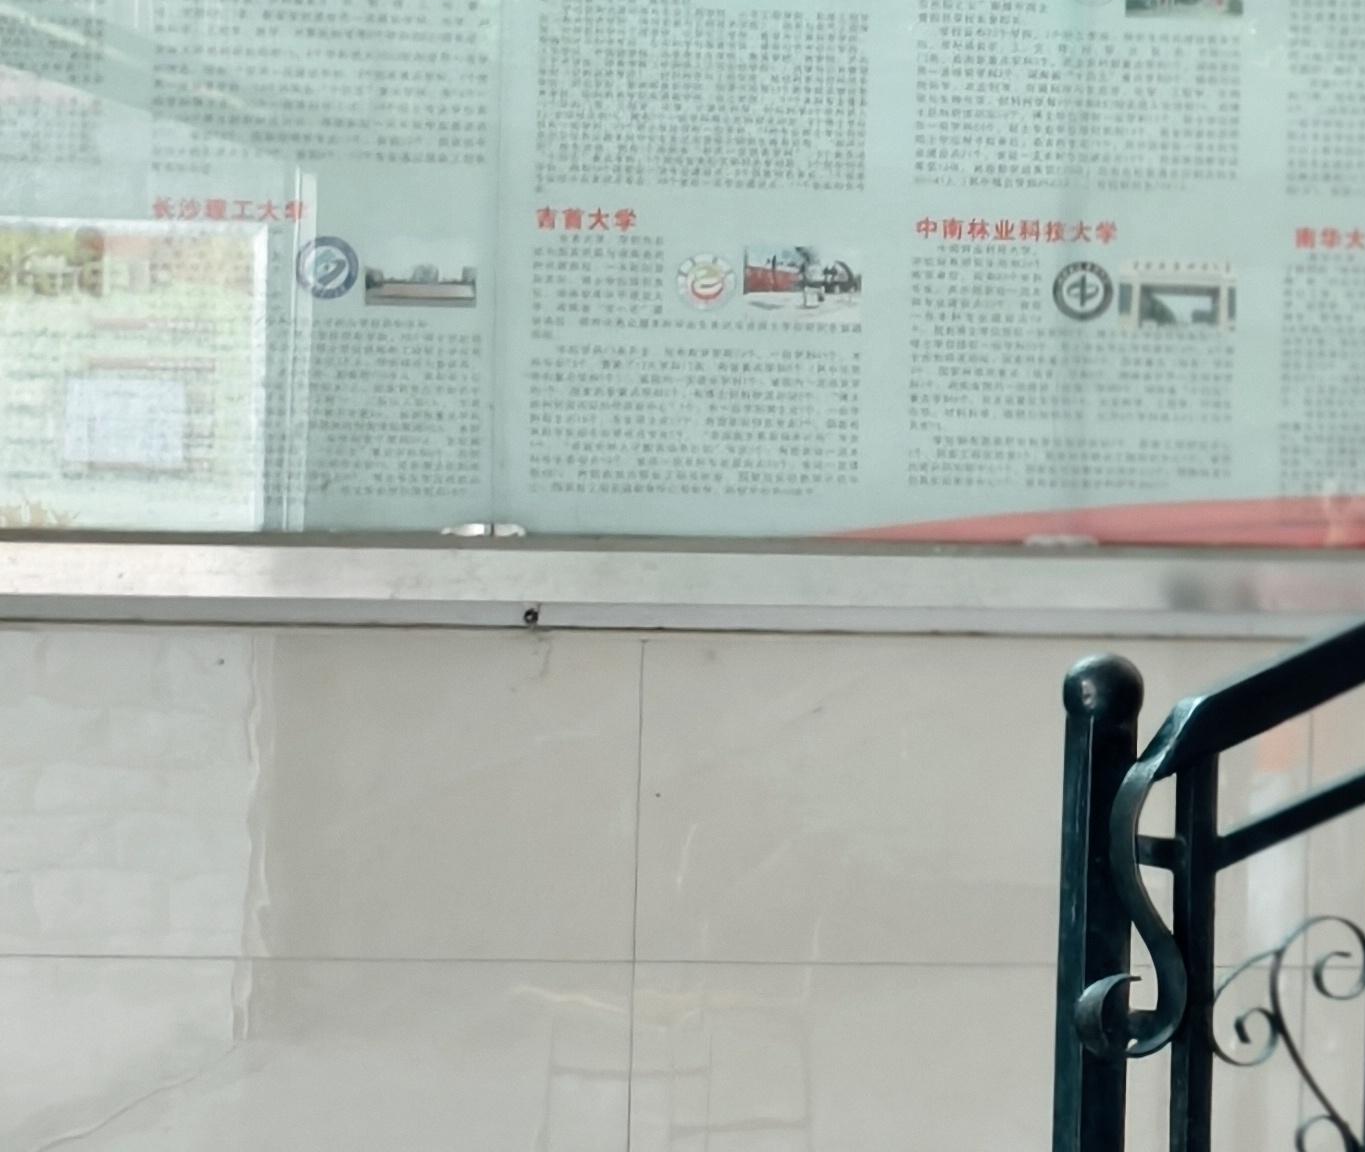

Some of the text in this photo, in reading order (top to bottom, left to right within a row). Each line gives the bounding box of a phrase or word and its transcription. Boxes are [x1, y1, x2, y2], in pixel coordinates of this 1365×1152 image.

[152, 198, 306, 221] 长沙理工大学
[536, 207, 637, 232] 吉首大学
[915, 217, 1118, 244] 中南林业科技大学
